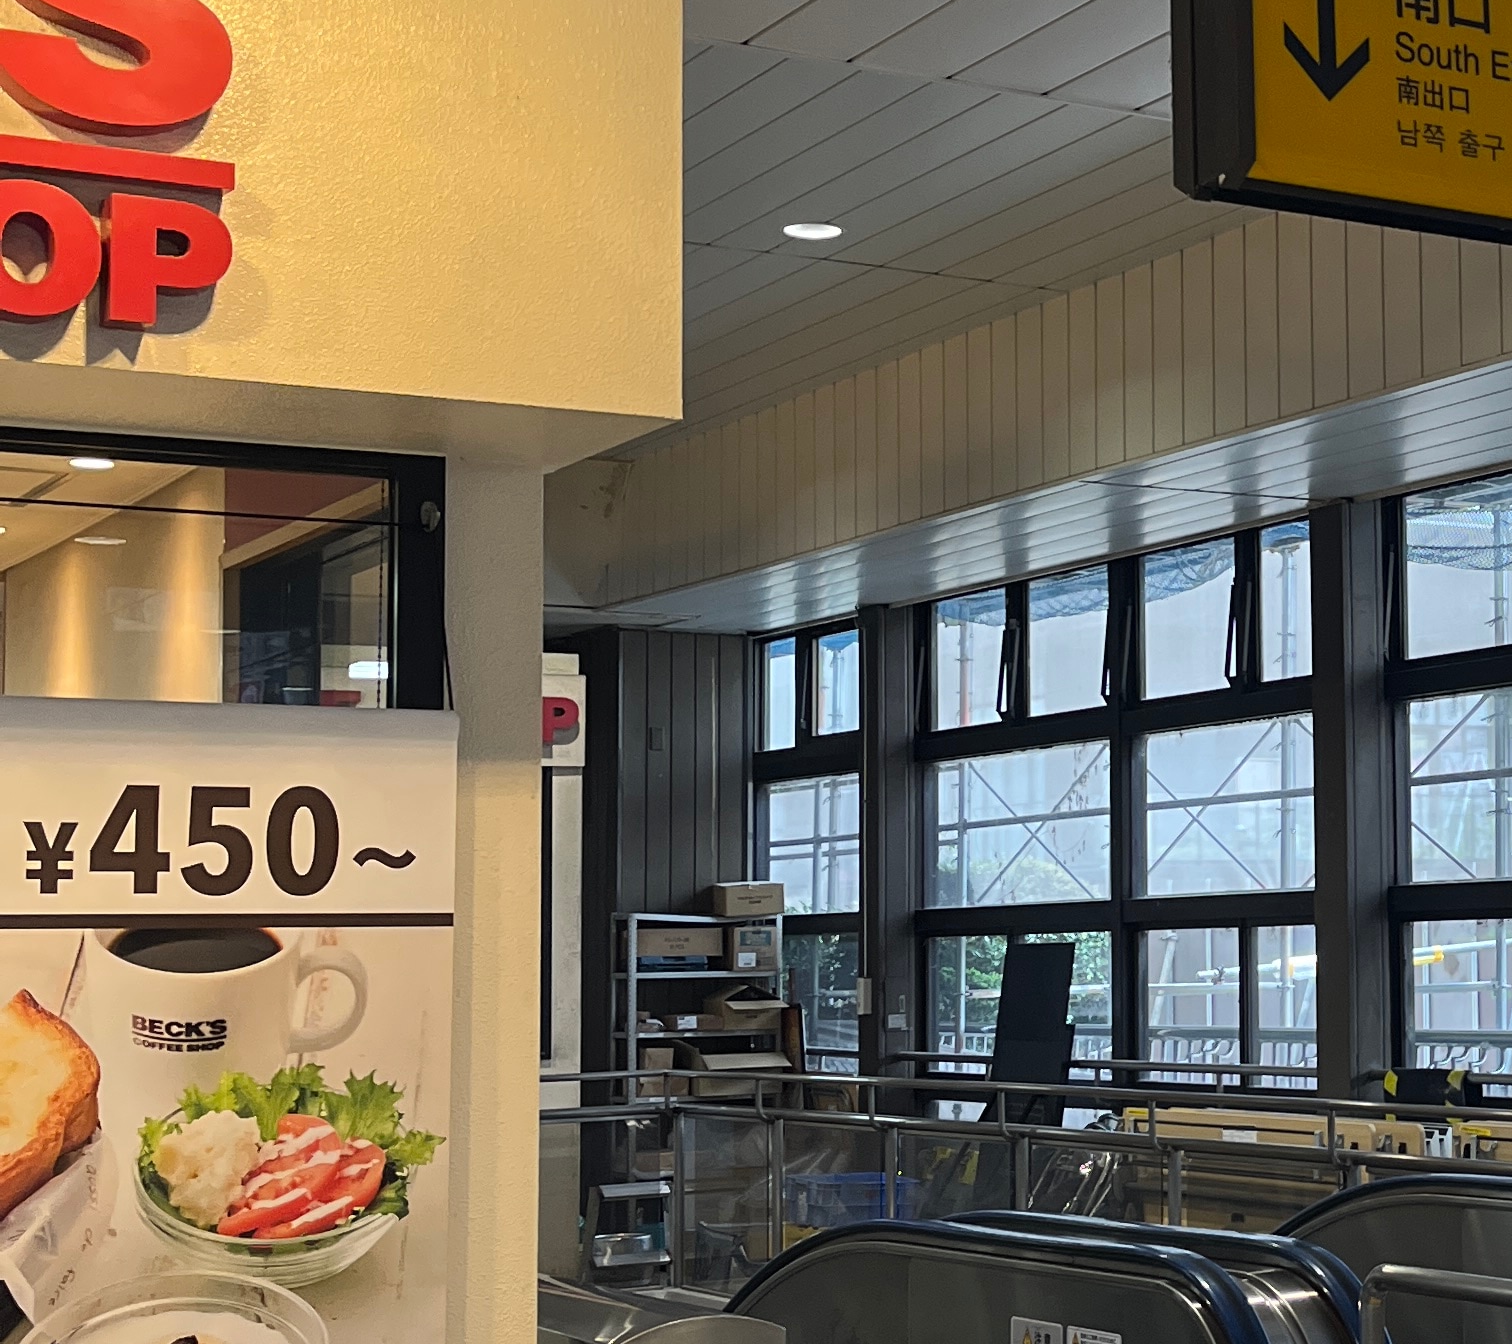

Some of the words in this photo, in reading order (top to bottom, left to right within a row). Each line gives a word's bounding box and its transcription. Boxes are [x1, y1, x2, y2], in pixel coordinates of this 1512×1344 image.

[1395, 32, 1480, 77] South
[1396, 76, 1471, 115] 南出口
[1397, 120, 1446, 152] 남쪽
[1458, 132, 1506, 162] 출구
[131, 1013, 228, 1038] BECK'S
